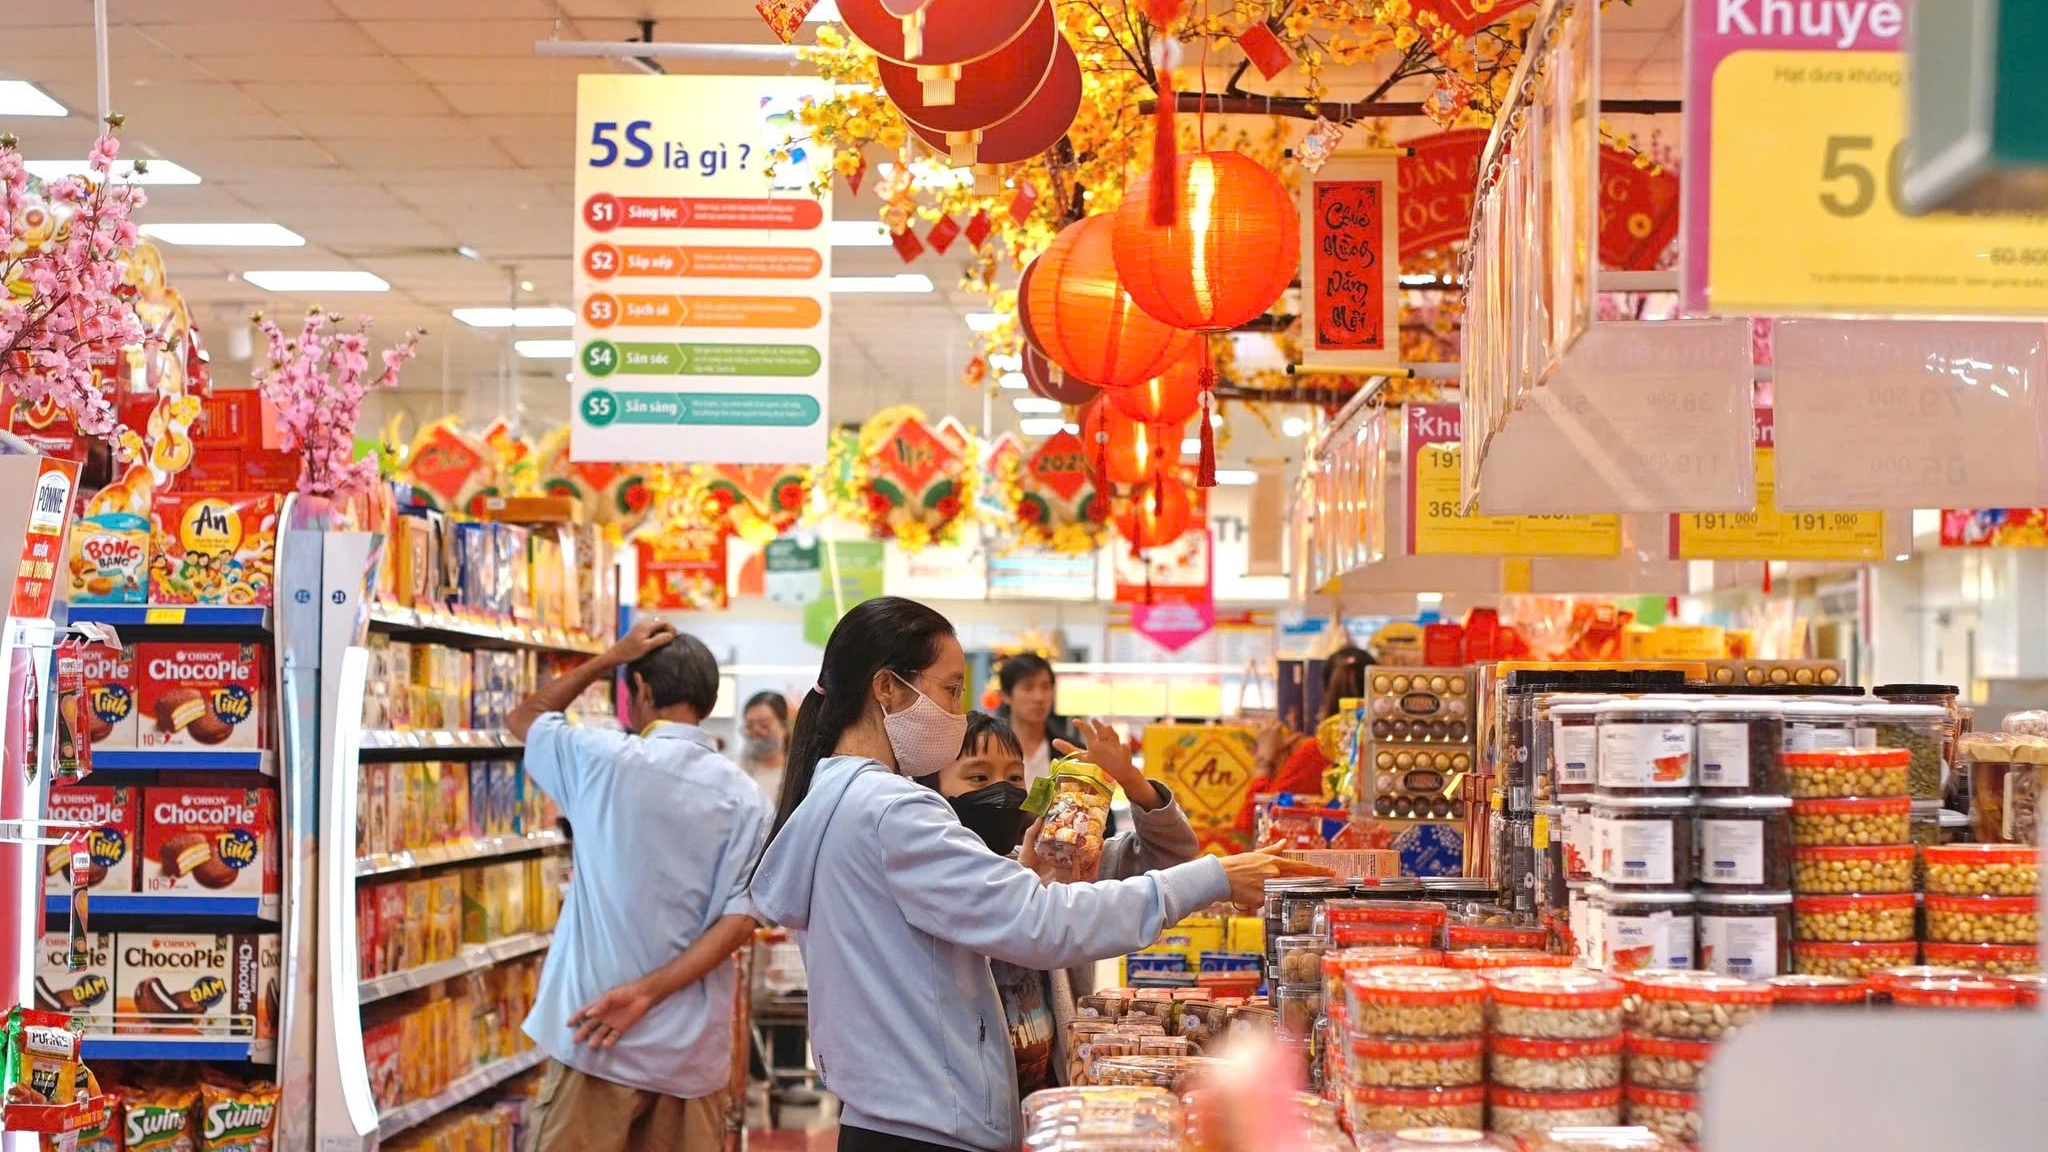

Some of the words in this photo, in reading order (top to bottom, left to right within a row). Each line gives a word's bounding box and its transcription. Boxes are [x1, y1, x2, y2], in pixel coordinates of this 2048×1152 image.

[589, 120, 654, 168] 5S
[664, 141, 690, 169] là
[700, 143, 727, 177] gì
[738, 143, 751, 169] ?
[591, 203, 613, 221] S1
[591, 252, 613, 270] S2
[590, 302, 612, 319] S3
[589, 348, 612, 365] S4
[588, 397, 610, 415] S5
[192, 505, 229, 536] An
[1693, 512, 1759, 530] 191.000
[1793, 513, 1858, 531] 191.000
[98, 556, 130, 568] BANG
[188, 652, 222, 661] ORION
[148, 659, 249, 680] ChocoPie
[191, 796, 228, 805] ORION
[154, 804, 255, 825] ChocoPie
[125, 947, 225, 968] ChocoPie
[238, 943, 254, 1012] ChocoPie
[204, 1100, 275, 1140] Swing
